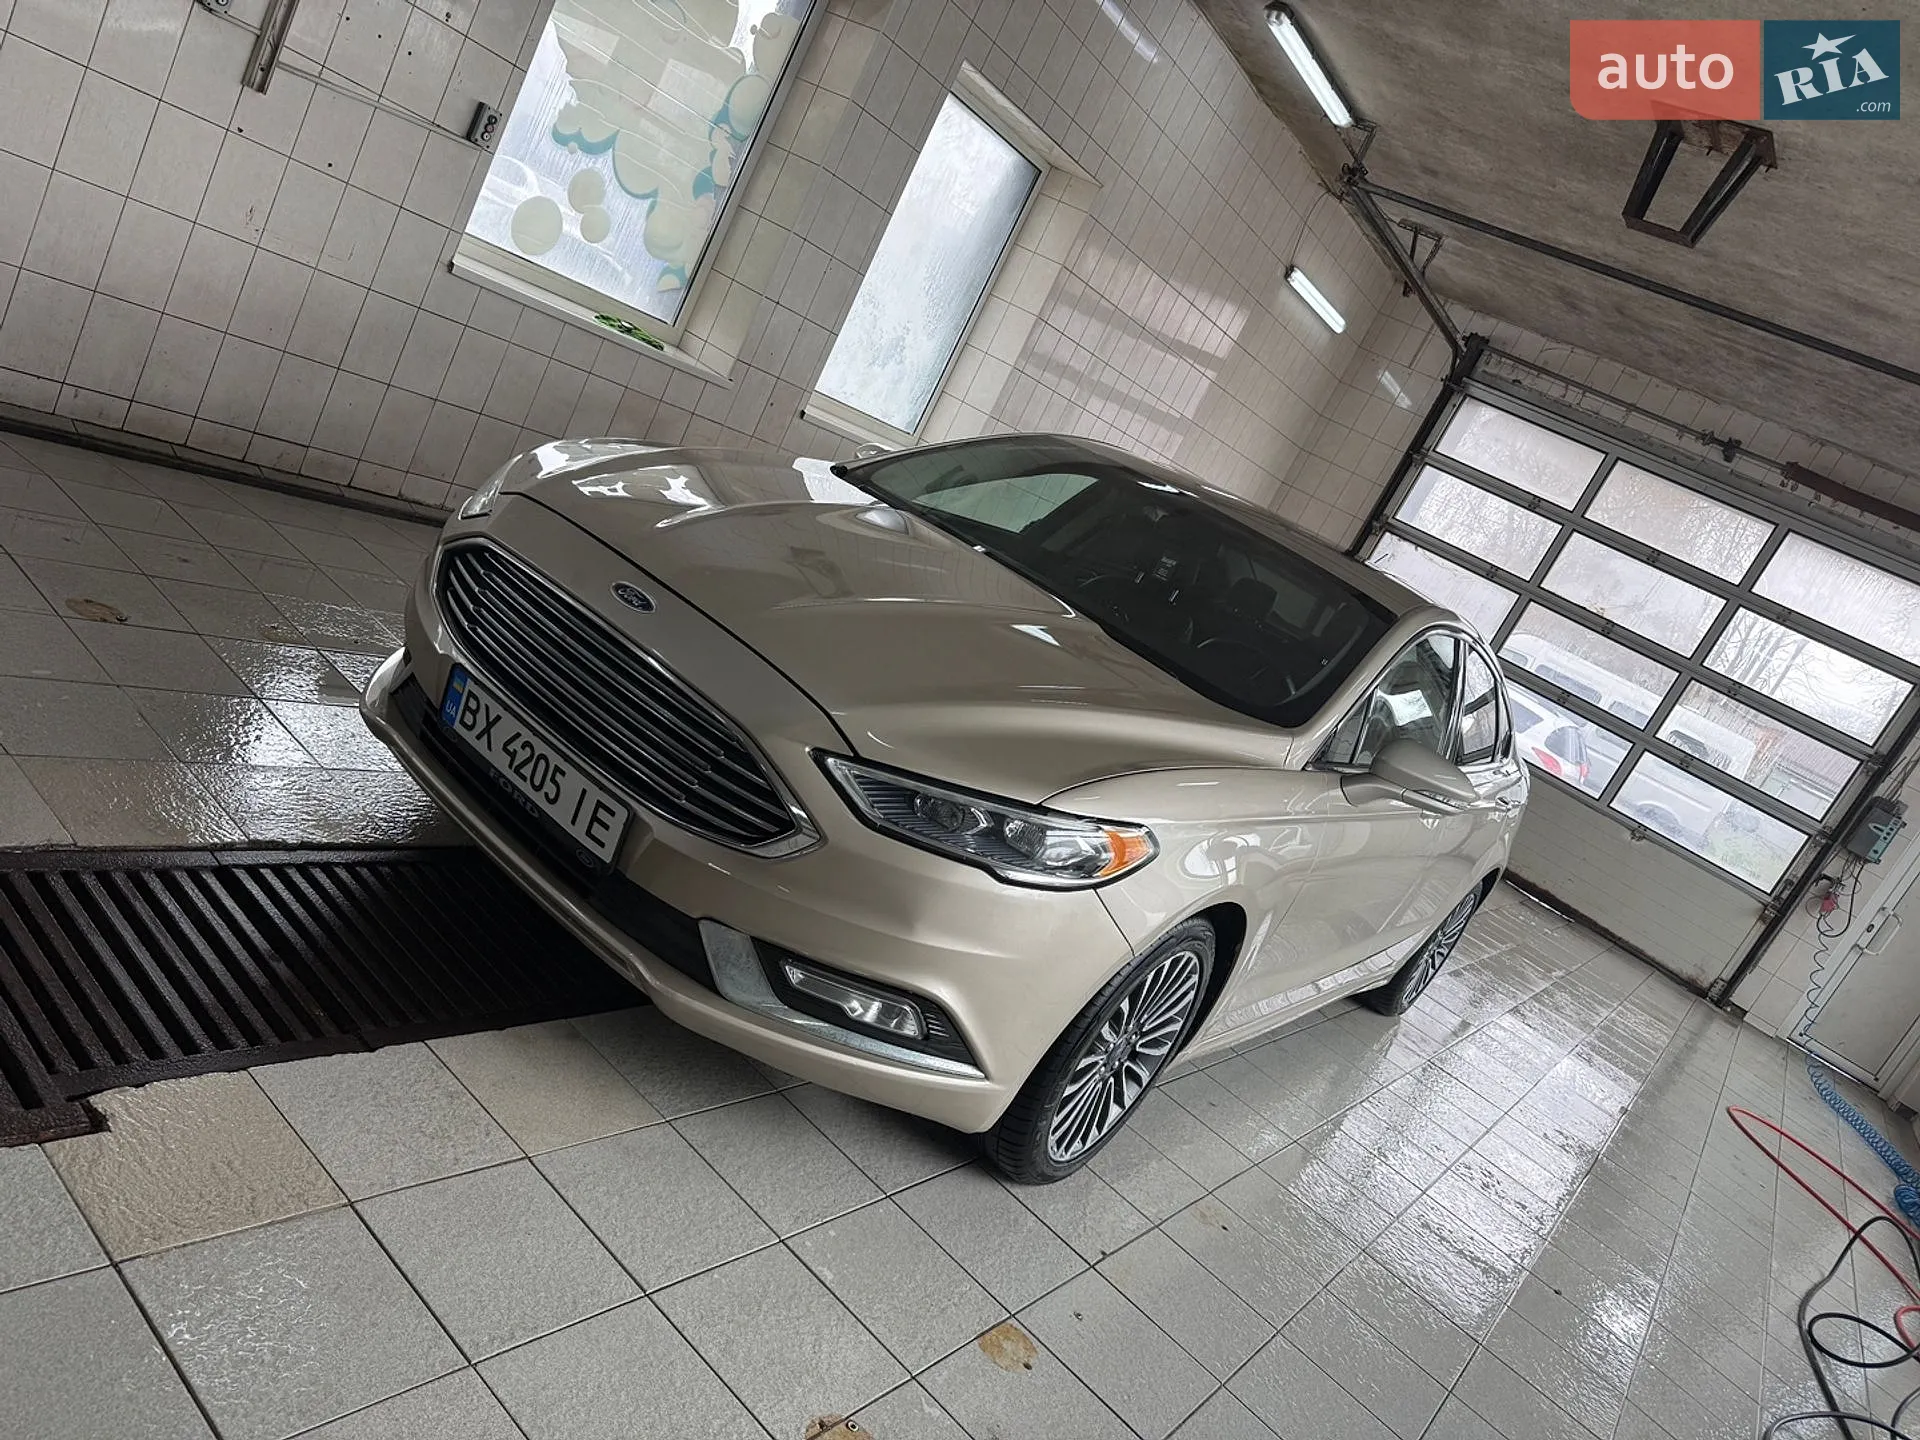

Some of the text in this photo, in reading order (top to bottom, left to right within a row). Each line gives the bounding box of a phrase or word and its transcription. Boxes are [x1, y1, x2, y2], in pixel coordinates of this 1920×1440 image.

[445, 700, 456, 718] UA
[459, 689, 616, 849] BX 4205 IE
